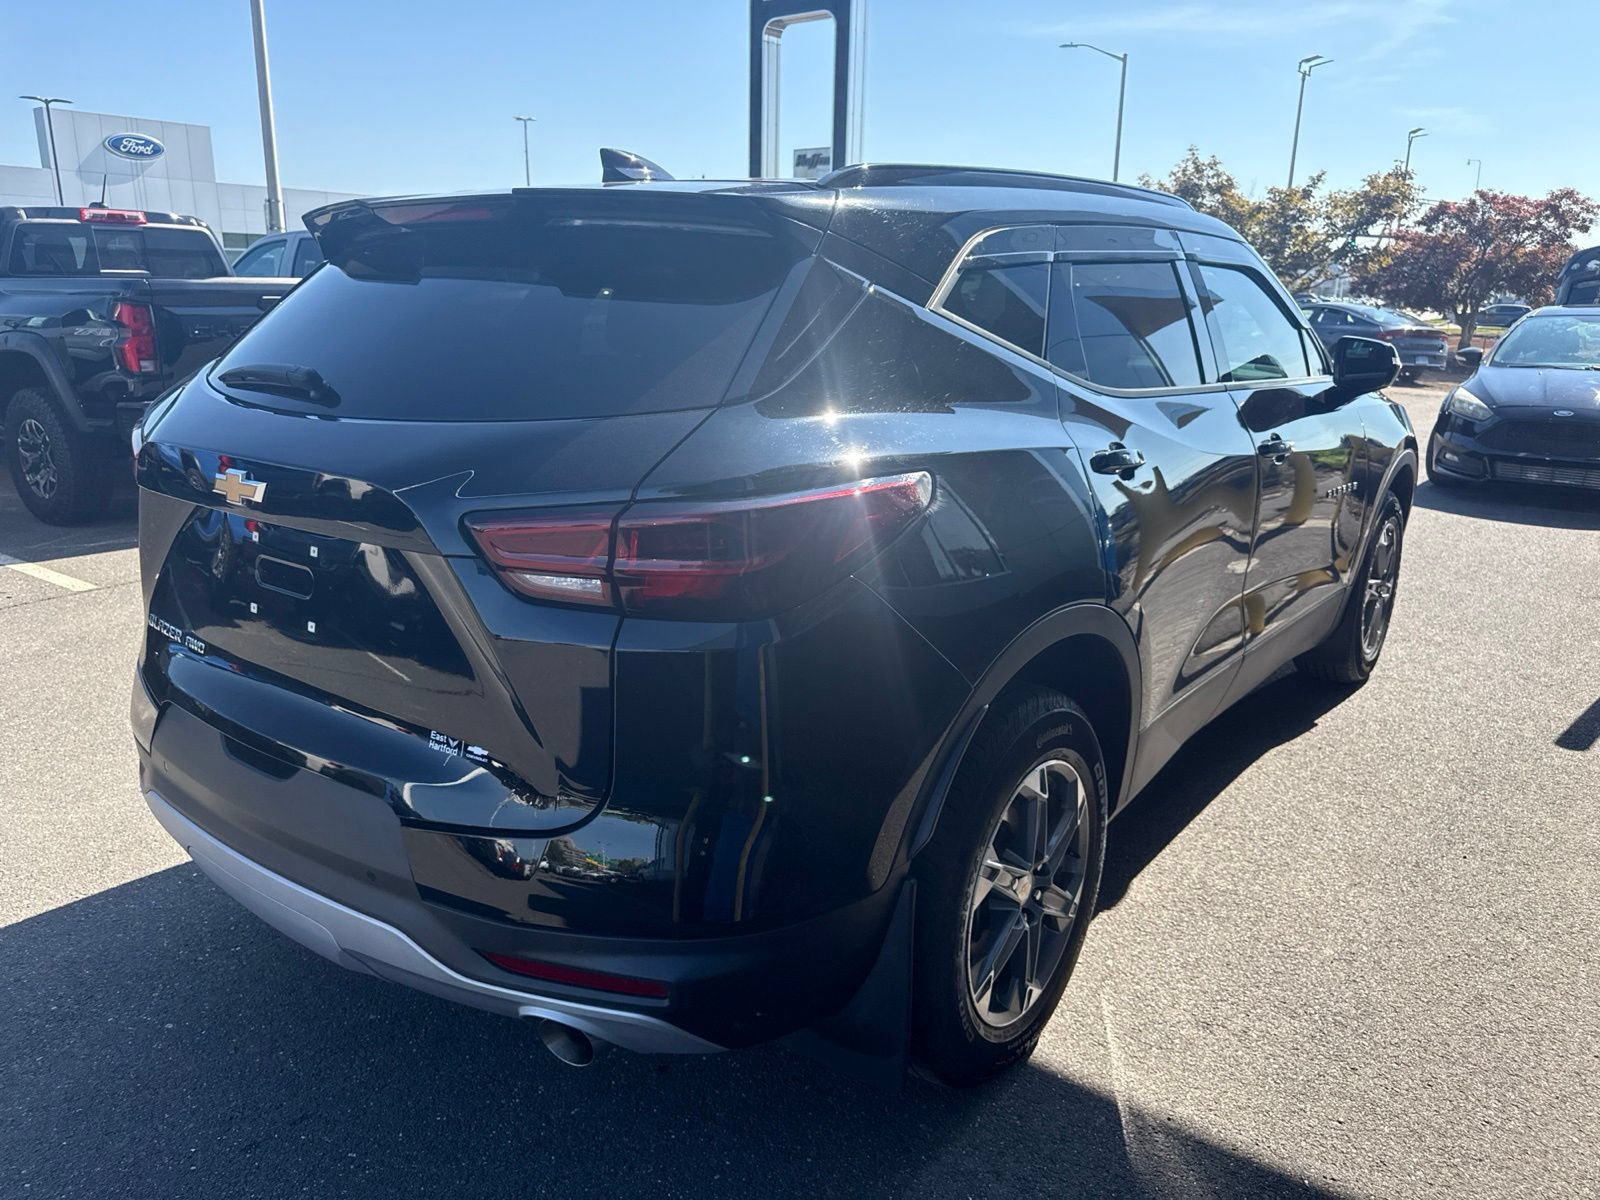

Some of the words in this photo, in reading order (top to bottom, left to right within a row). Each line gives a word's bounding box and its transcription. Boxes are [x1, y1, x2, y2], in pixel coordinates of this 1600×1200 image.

[120, 137, 154, 155] Ford
[149, 613, 182, 643] BLAZER
[185, 635, 206, 654] AWD
[430, 730, 447, 743] East
[428, 739, 459, 756] Hartford
